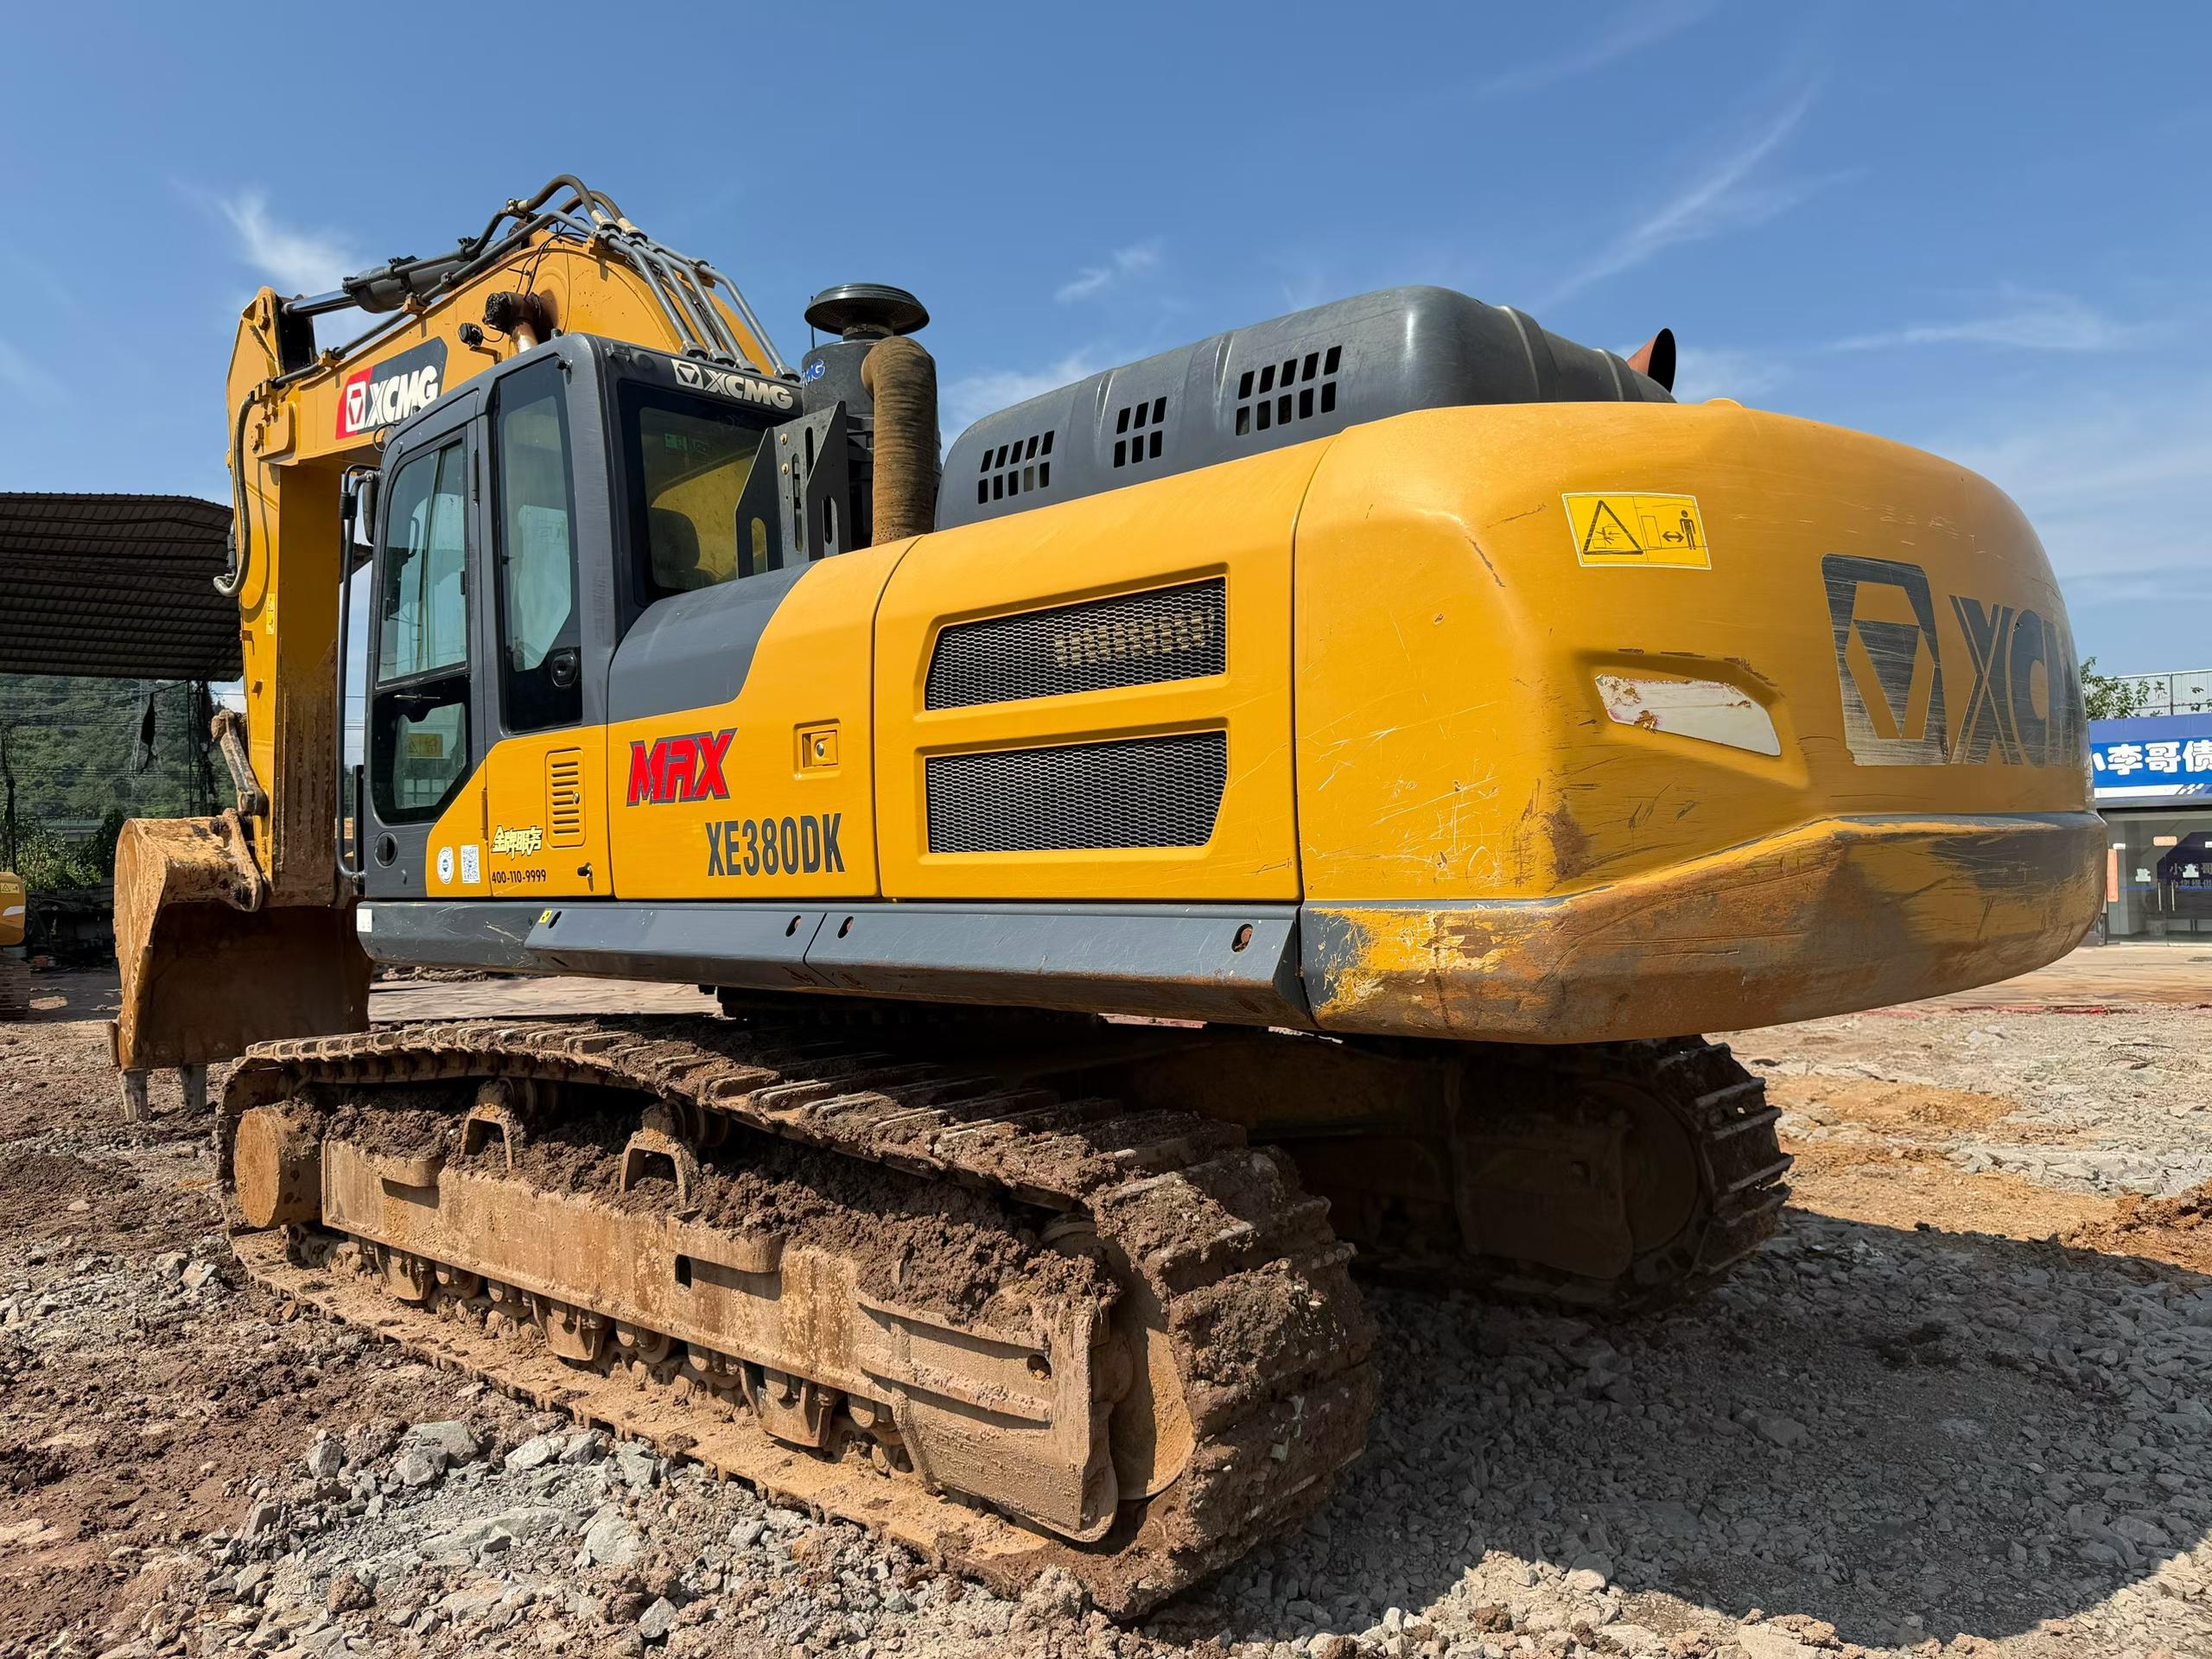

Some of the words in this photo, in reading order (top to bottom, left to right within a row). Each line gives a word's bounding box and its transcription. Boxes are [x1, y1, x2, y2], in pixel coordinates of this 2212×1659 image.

[365, 365, 438, 427] XCMG
[703, 368, 793, 410] XCMG
[626, 728, 739, 807] MAX
[2092, 739, 2212, 776] 李哥债
[491, 824, 543, 861] 金牌服务
[705, 813, 845, 877] XE380DK
[492, 868, 546, 883] 400-110-9999
